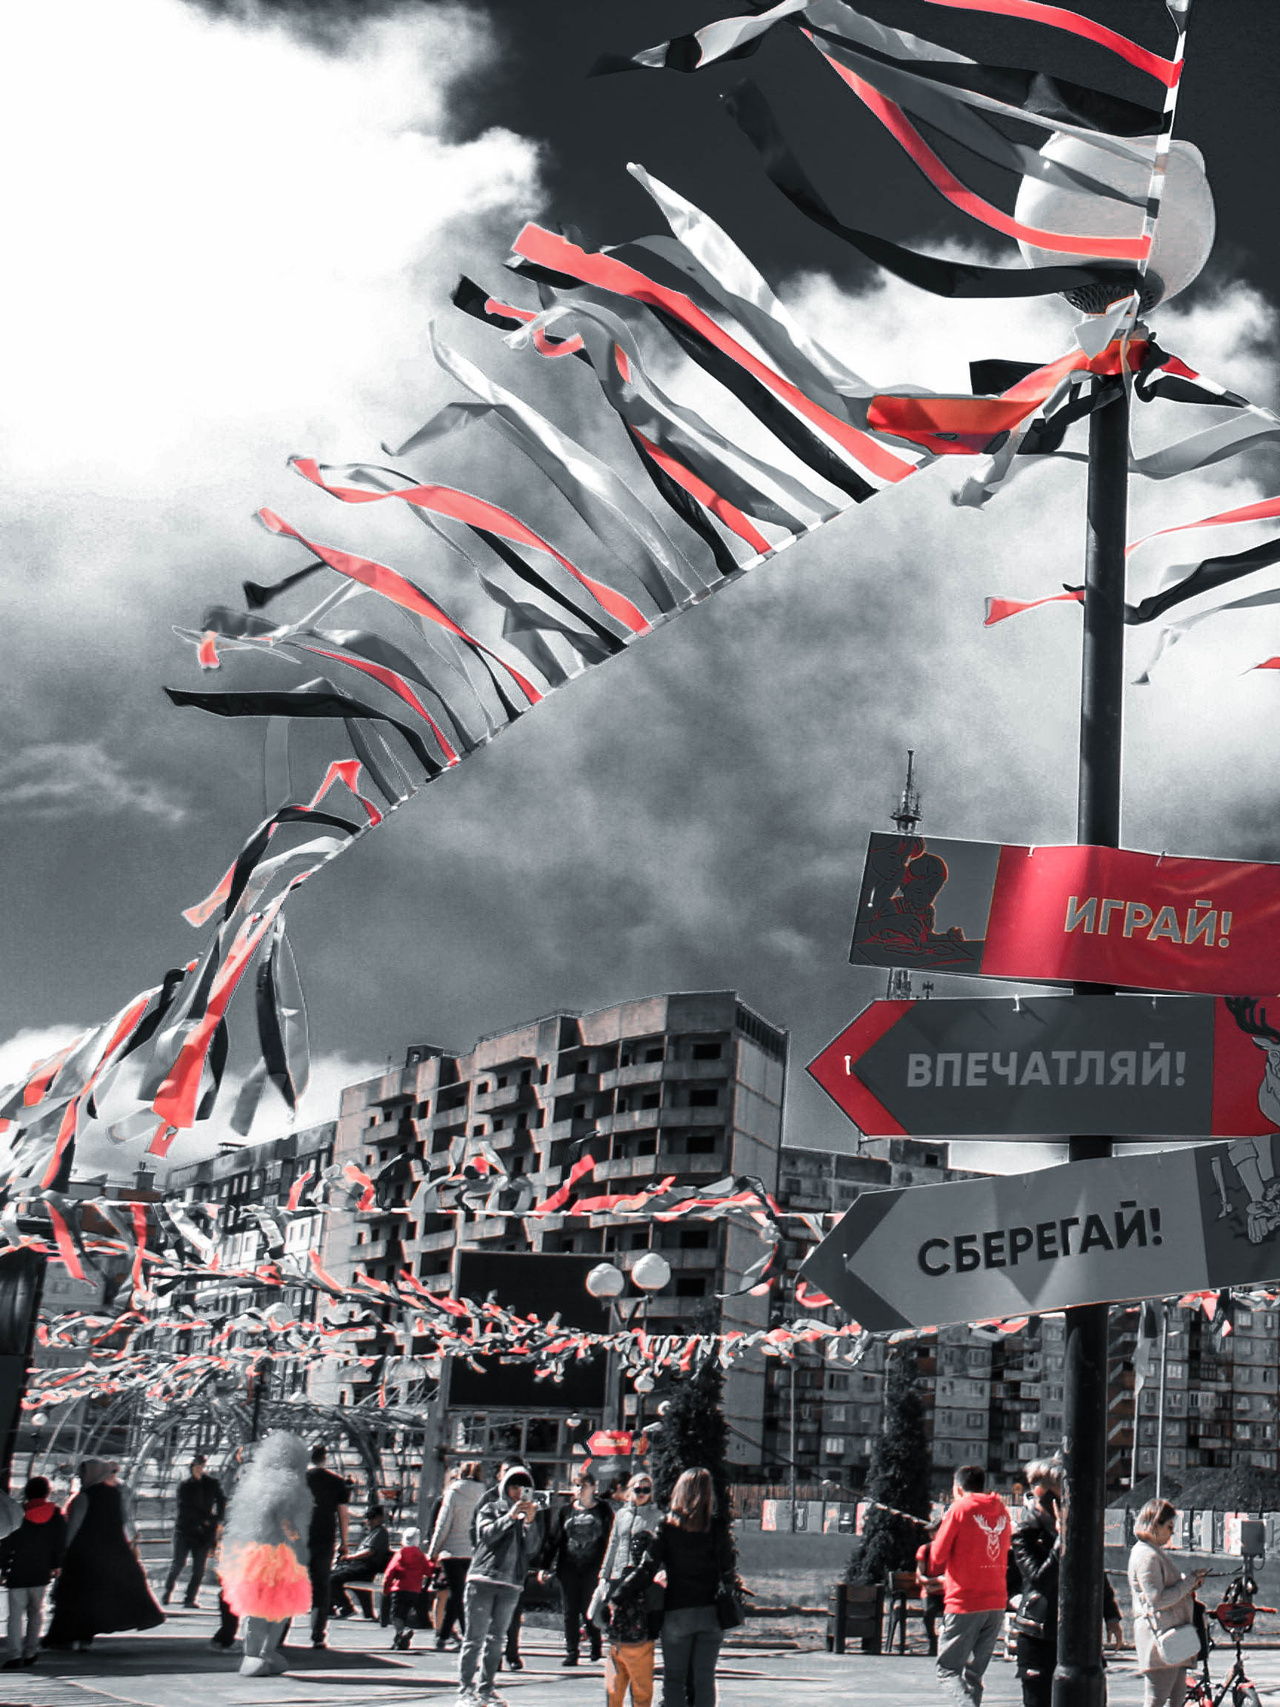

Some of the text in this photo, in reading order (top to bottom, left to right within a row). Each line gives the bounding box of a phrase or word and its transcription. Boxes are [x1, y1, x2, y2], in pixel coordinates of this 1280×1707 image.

[1063, 896, 1233, 949] ИГРАЙ!
[907, 1042, 1186, 1088] ВПЕЧАТЛЯЙ!
[917, 1201, 1163, 1277] СБЕРЕГАЙ!
